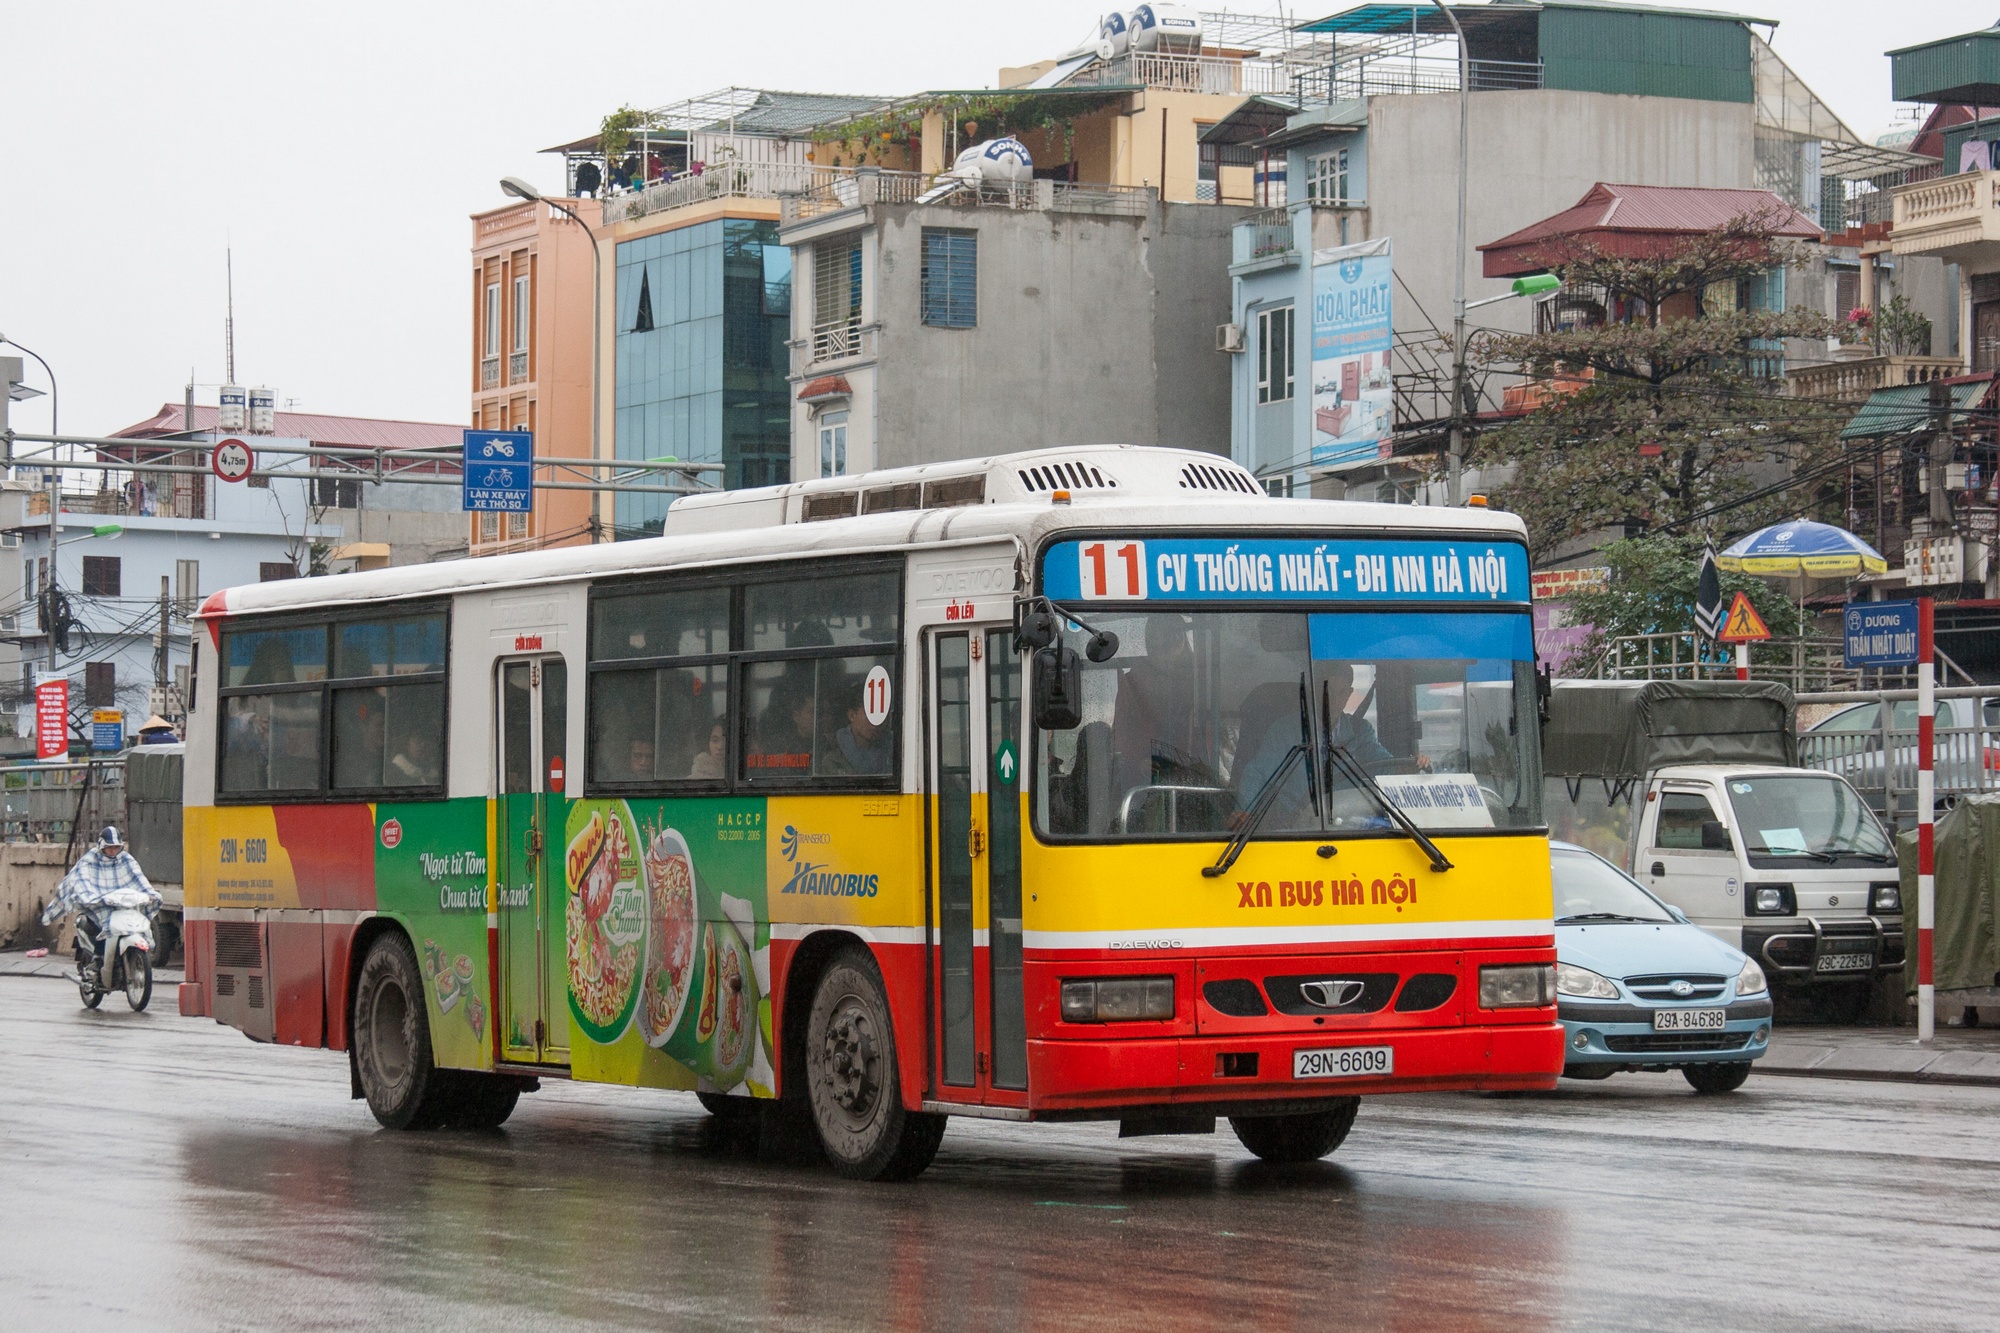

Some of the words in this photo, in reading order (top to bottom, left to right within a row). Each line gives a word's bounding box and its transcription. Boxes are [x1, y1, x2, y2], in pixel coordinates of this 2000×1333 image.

[1316, 286, 1345, 323] HÒA
[1349, 279, 1388, 318] PHÁT
[220, 452, 246, 466] 4,75m
[470, 488, 489, 499] LÀN
[491, 491, 504, 499] XE
[505, 489, 526, 500] MÁY
[474, 500, 487, 508] XE
[1084, 543, 1140, 596] 11
[1157, 553, 1188, 592] CV
[1193, 544, 1274, 592] THỐNG
[1391, 555, 1427, 593] NN
[1431, 548, 1464, 593] HÀ
[1467, 548, 1508, 600] NỘI
[1871, 629, 1894, 660] NHẬT
[867, 677, 886, 714] 11
[221, 838, 238, 863] 29N
[245, 838, 267, 863] 6609
[451, 851, 464, 875] từ
[465, 851, 487, 875] Tôm
[620, 867, 638, 880] CUP
[781, 861, 879, 898] HANOIBUS
[440, 884, 468, 909] Chua
[469, 883, 481, 908] từ
[616, 887, 642, 914] Tôm
[1279, 879, 1324, 908] BUS
[1331, 872, 1365, 906] HÀ
[1371, 872, 1417, 913] NỘI
[605, 905, 642, 936] Chanh
[1109, 939, 1184, 950] DAEWOO
[1299, 1050, 1387, 1075] 29N-6609
